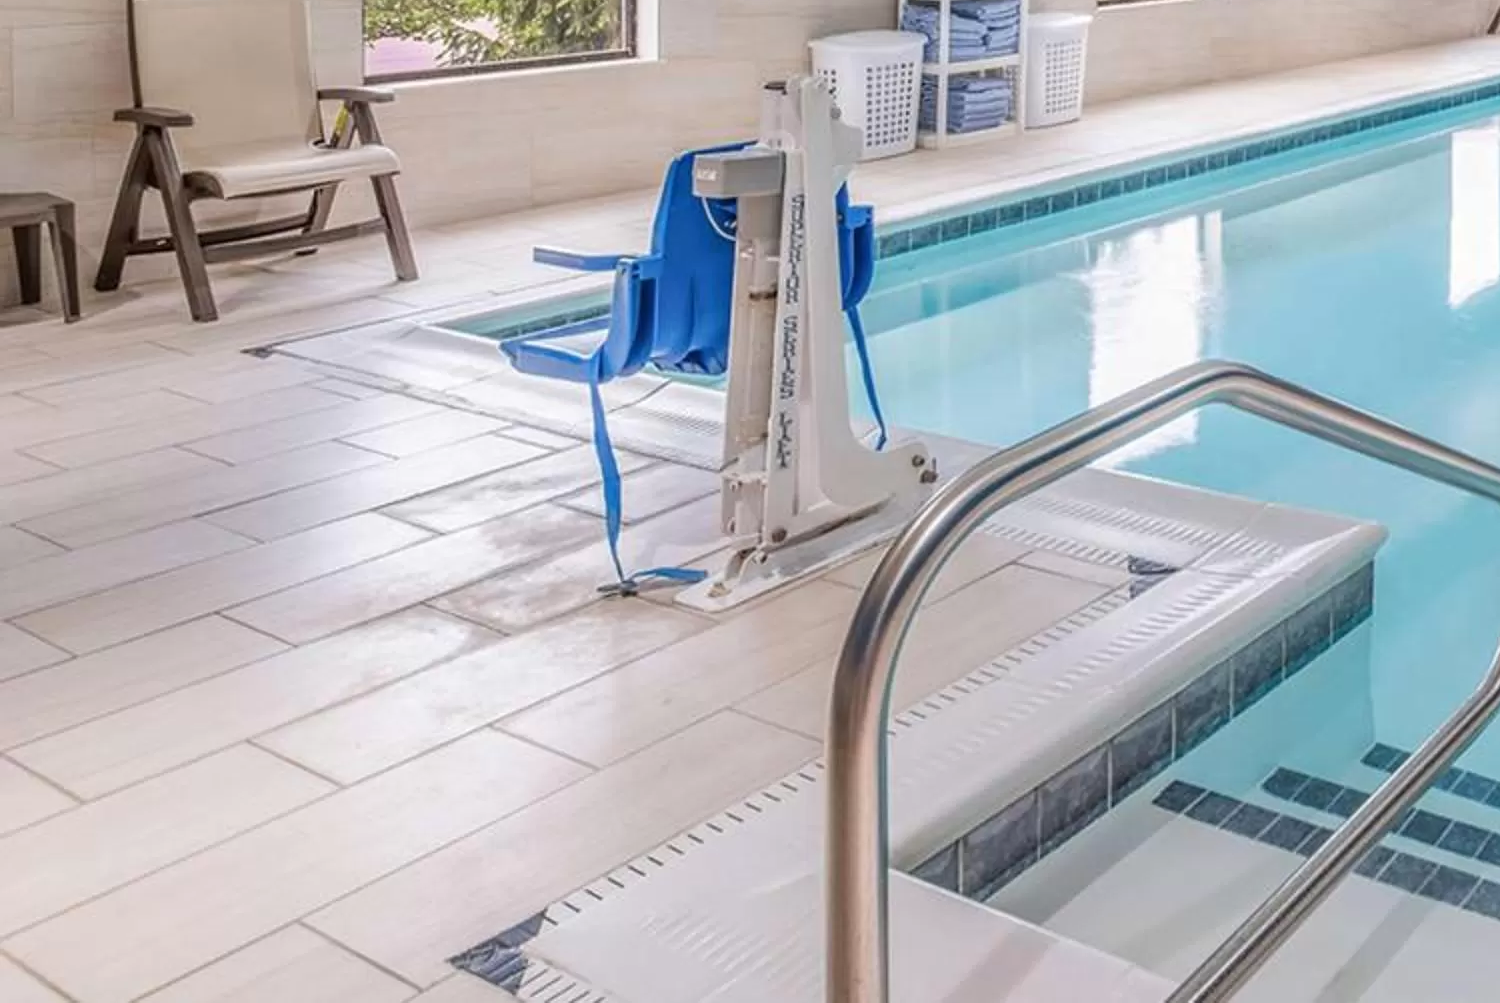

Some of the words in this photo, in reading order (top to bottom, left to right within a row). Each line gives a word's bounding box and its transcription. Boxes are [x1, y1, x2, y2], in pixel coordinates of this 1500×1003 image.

[785, 193, 805, 305] SUPERIOR
[779, 315, 798, 400] SERIES
[775, 410, 793, 469] LIFT
